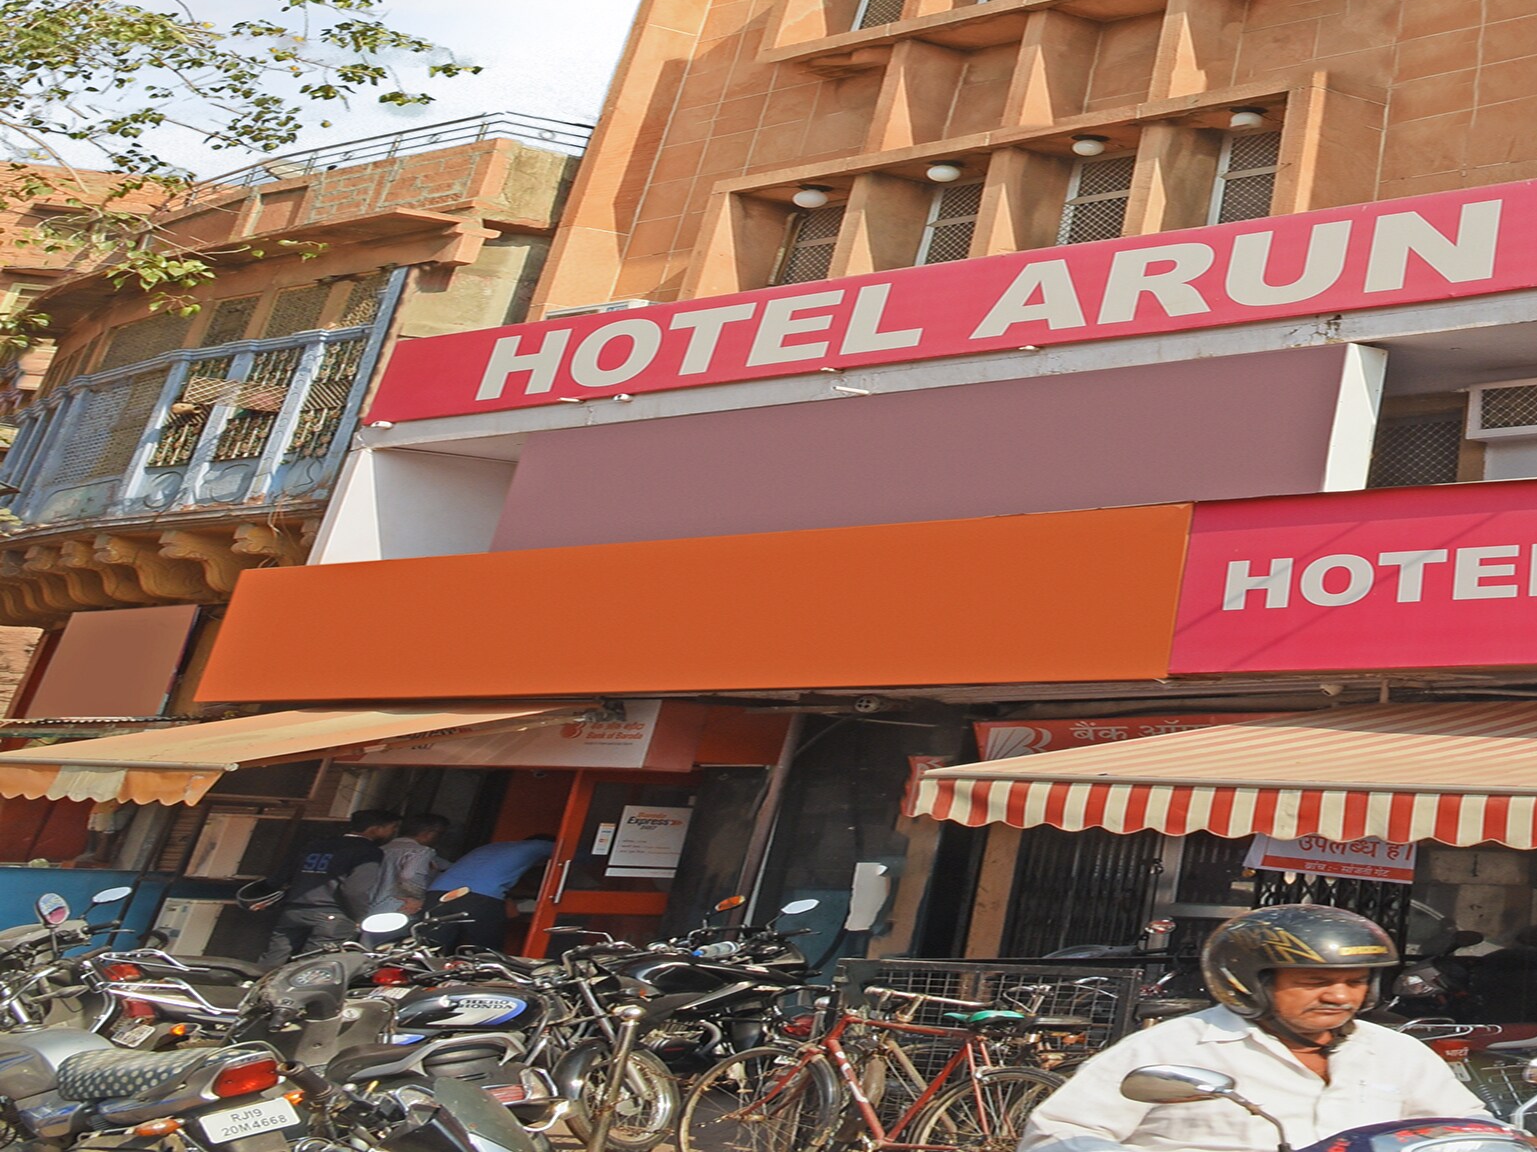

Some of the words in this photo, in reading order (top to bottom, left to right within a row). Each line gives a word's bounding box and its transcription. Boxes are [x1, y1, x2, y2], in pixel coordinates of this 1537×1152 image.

[475, 282, 924, 402] HOTEL
[971, 198, 1504, 339] ARUN
[1068, 721, 1129, 741] बैंक
[230, 1108, 263, 1122] RJ19
